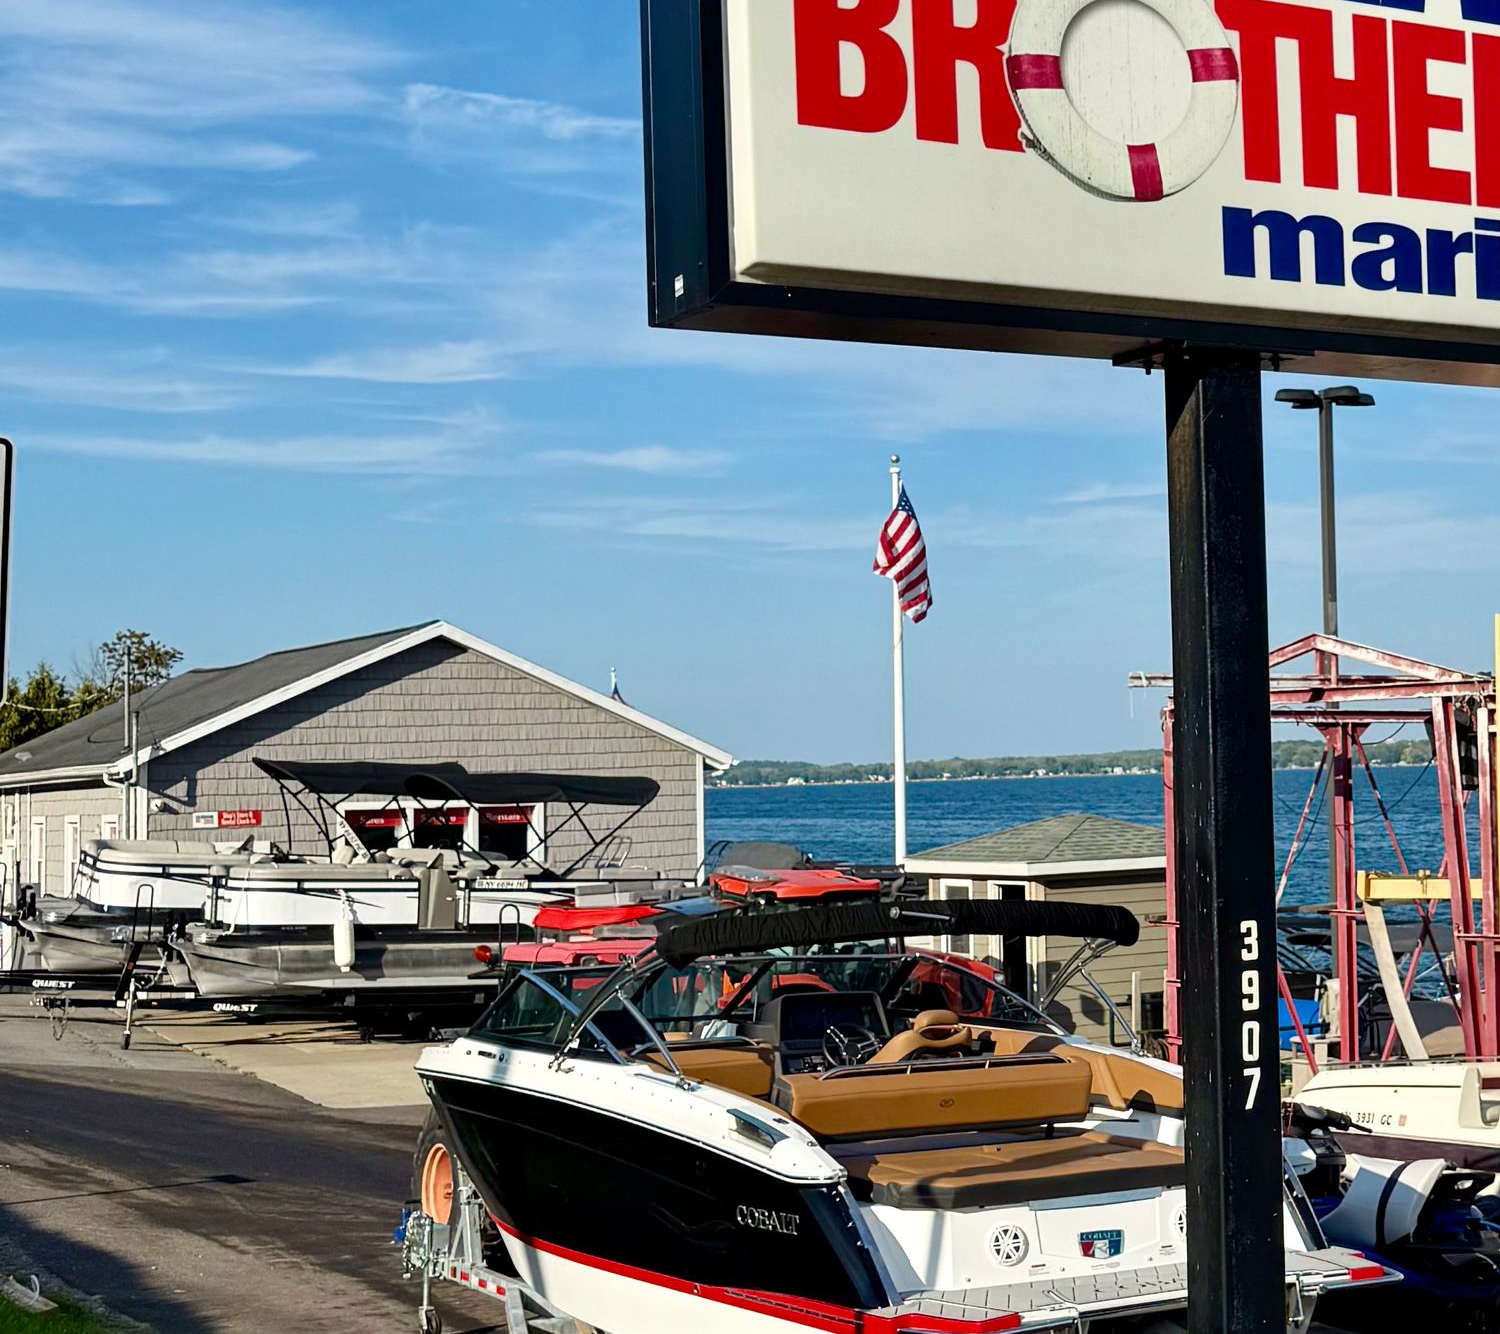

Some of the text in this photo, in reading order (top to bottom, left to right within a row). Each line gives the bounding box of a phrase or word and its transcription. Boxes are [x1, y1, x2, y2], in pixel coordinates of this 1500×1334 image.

[1240, 920, 1261, 1110] 3907
[1356, 1112, 1375, 1124] 3931
[735, 1204, 800, 1235] COBALT
